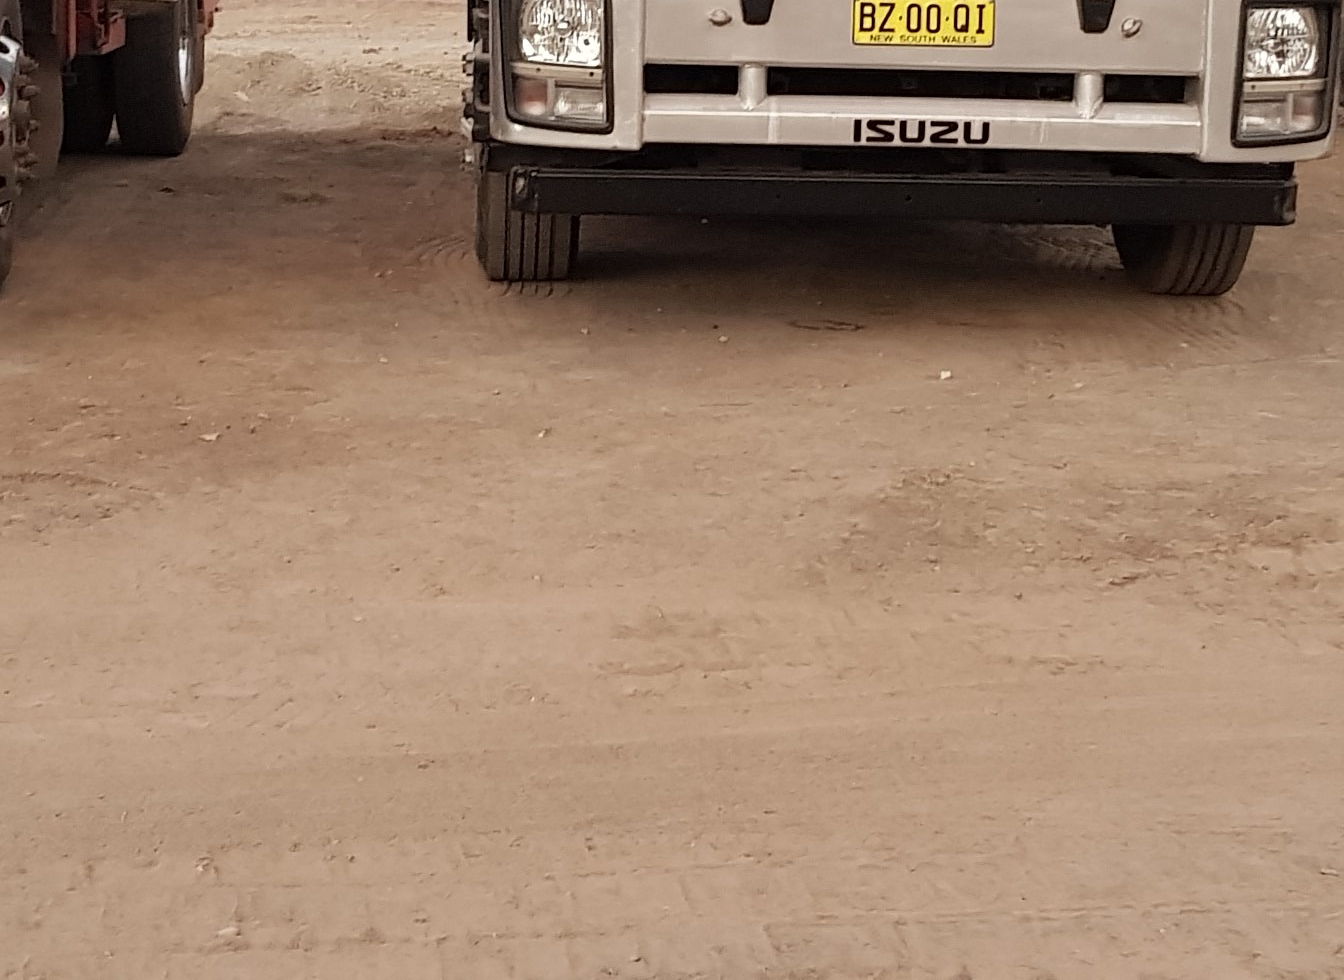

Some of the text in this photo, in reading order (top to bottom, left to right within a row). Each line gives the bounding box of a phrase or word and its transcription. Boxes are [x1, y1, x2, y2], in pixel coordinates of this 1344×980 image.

[869, 34, 977, 44] NEW SOUTH WALES
[853, 119, 991, 144] ISUZU
